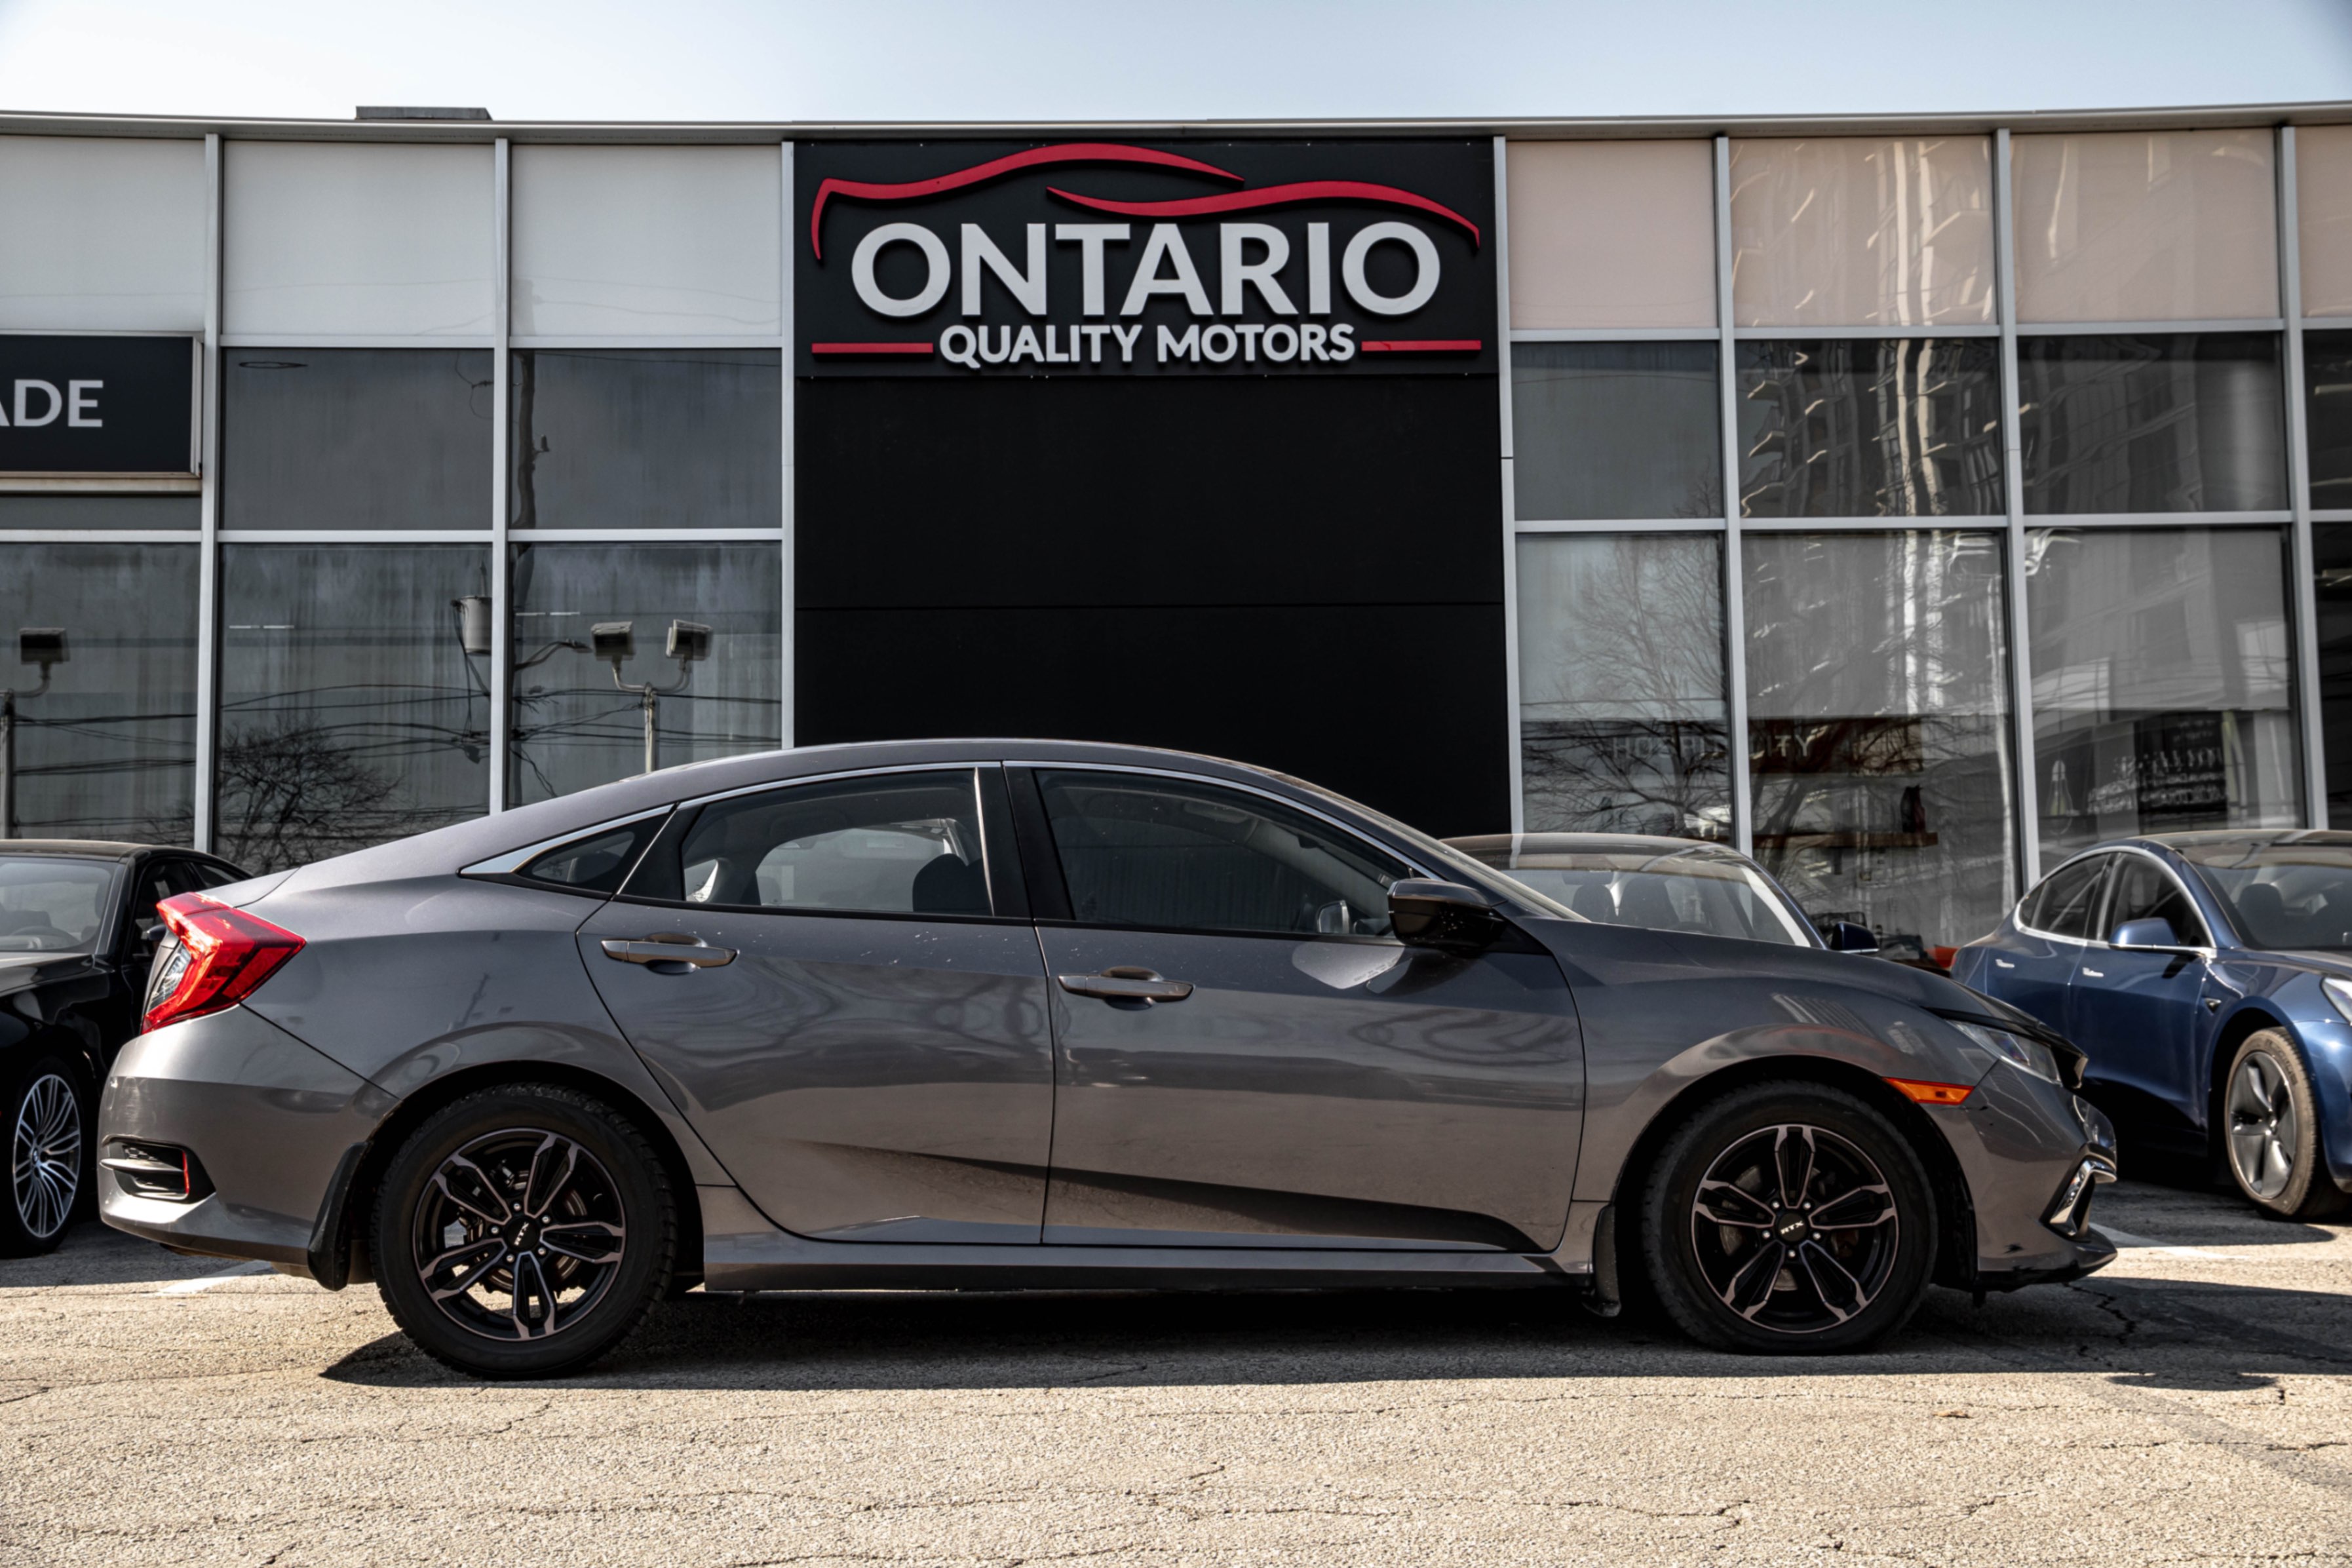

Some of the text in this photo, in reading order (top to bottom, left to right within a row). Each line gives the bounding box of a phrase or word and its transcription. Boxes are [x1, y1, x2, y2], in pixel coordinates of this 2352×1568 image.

[852, 222, 1440, 316] ONTARIO
[940, 324, 1355, 368] QUALITY MOTORS
[0, 379, 103, 427] DE
[1781, 1220, 1803, 1234] RTX
